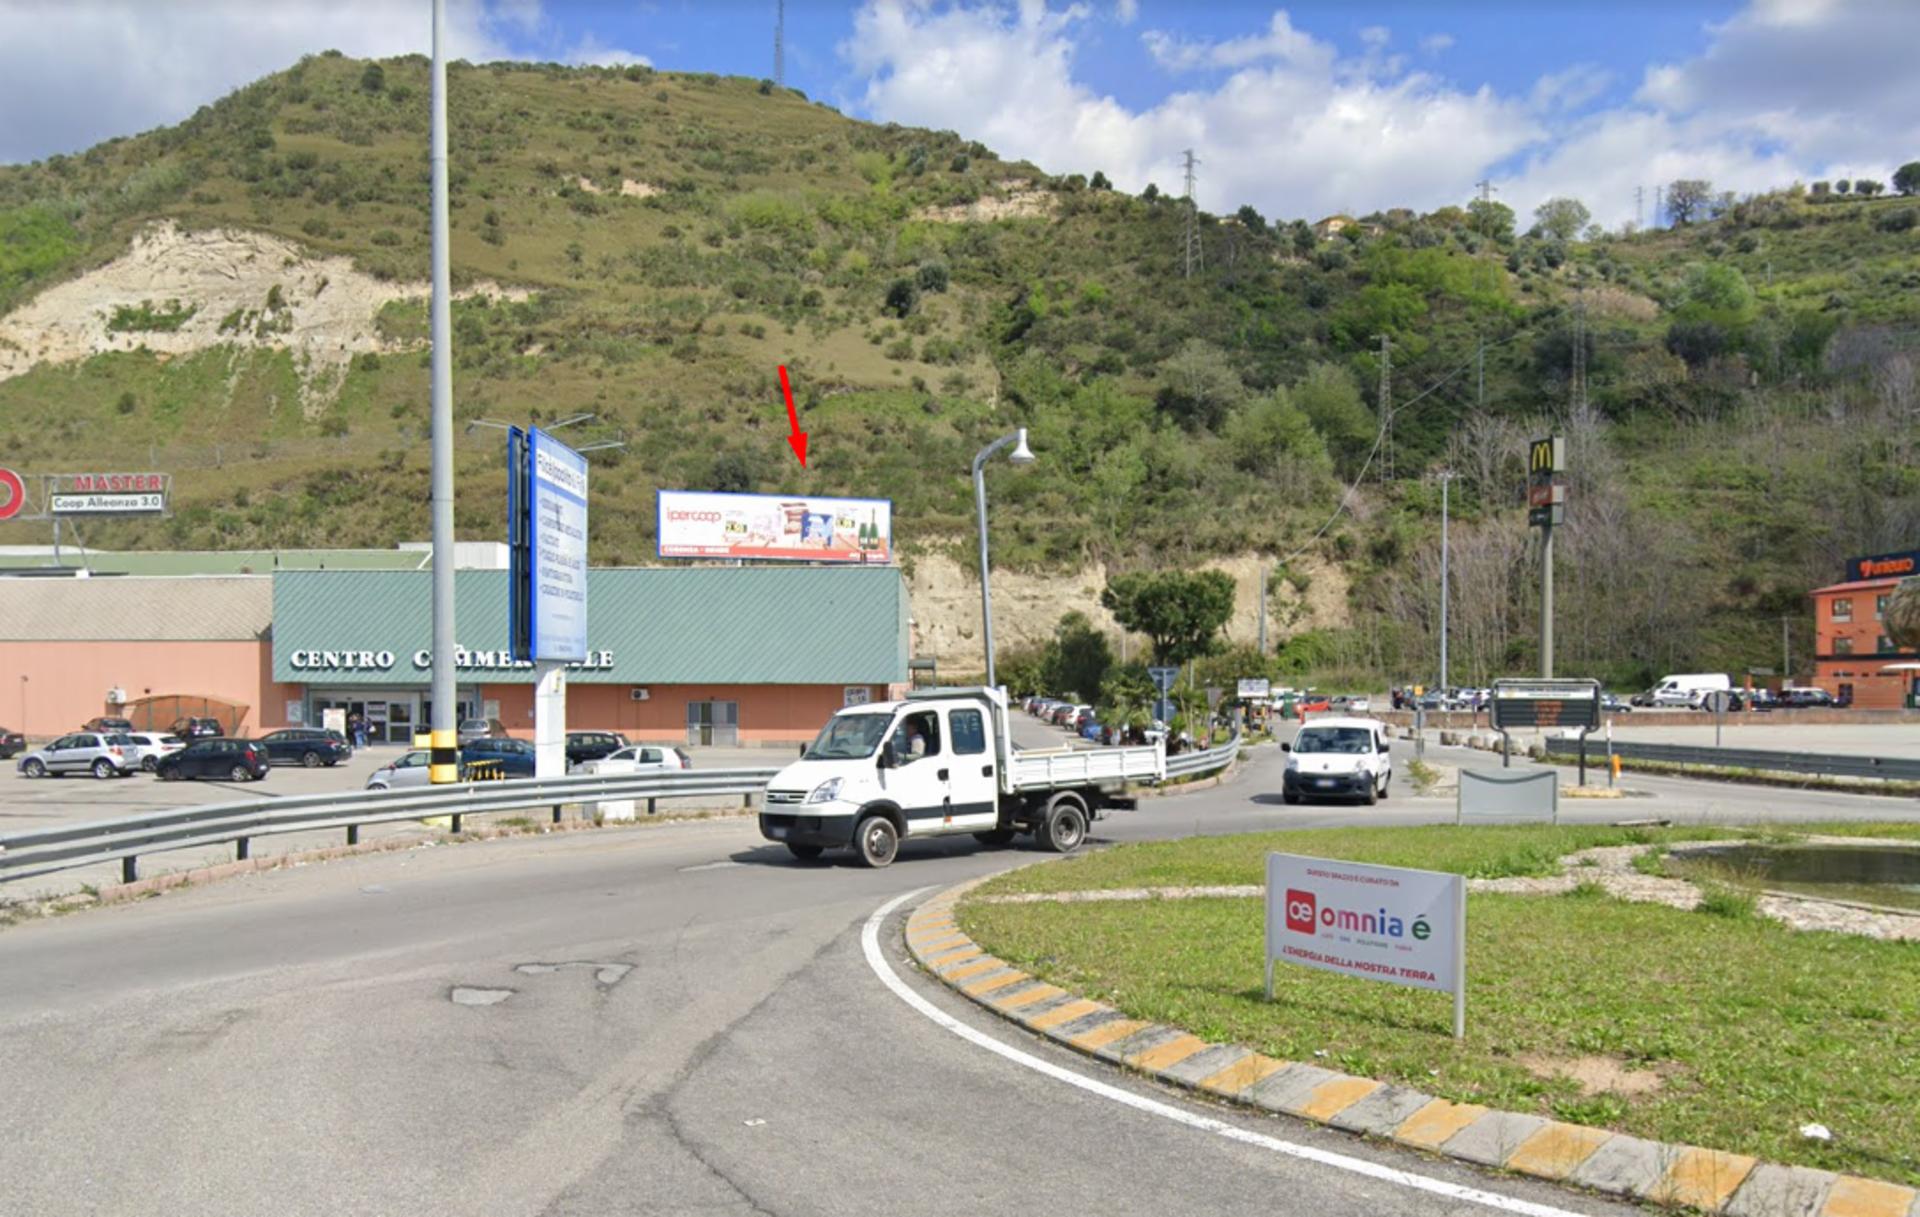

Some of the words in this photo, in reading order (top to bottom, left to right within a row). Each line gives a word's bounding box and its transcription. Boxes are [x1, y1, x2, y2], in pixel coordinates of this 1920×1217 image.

[74, 475, 161, 491] MASTER
[54, 497, 84, 508] Coop
[142, 496, 160, 506] 3.0
[667, 507, 722, 522] ipercoop
[290, 649, 395, 668] CENTRO
[1320, 908, 1404, 938] omnia
[1324, 954, 1353, 968] DELLA
[1355, 960, 1397, 975] NOSTRA
[1400, 967, 1436, 982] TERRA
